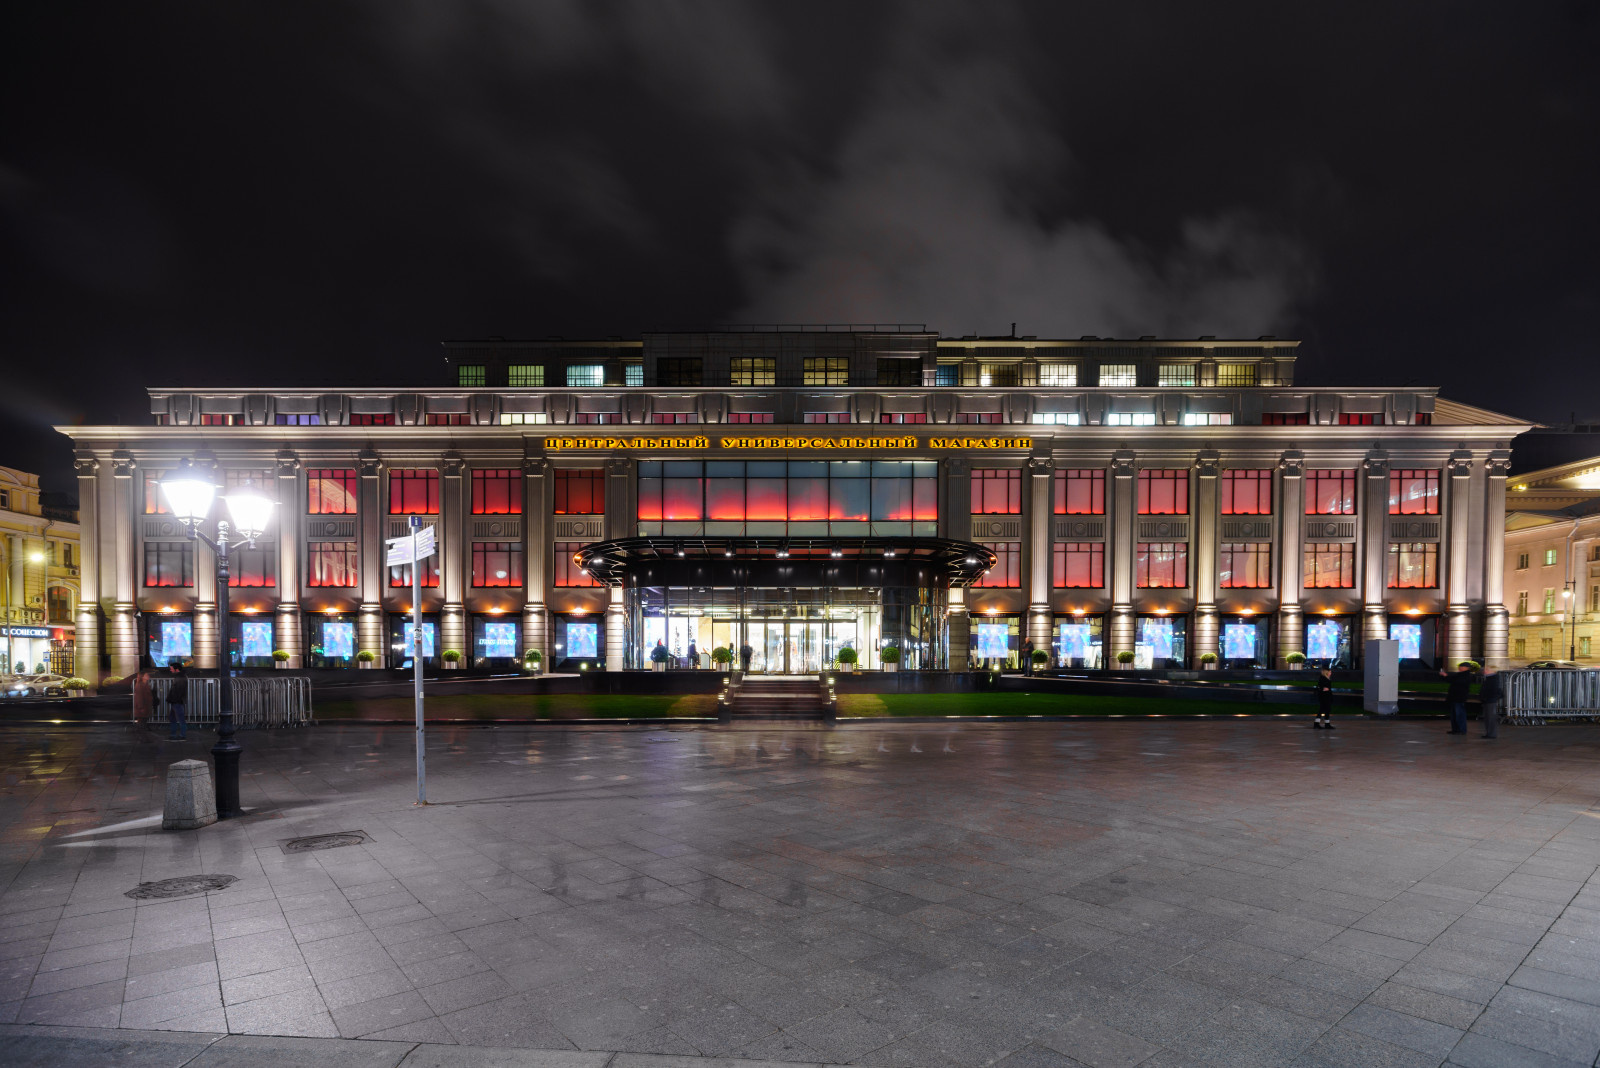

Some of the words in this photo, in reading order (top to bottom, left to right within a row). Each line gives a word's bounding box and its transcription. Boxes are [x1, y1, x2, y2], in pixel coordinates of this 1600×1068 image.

[545, 436, 708, 449] ЦЕНТРАЛЬНЫЙ
[722, 436, 917, 448] УНИВЕРСАЛЬНЫЙ
[931, 438, 1031, 448] МАГАЗИН
